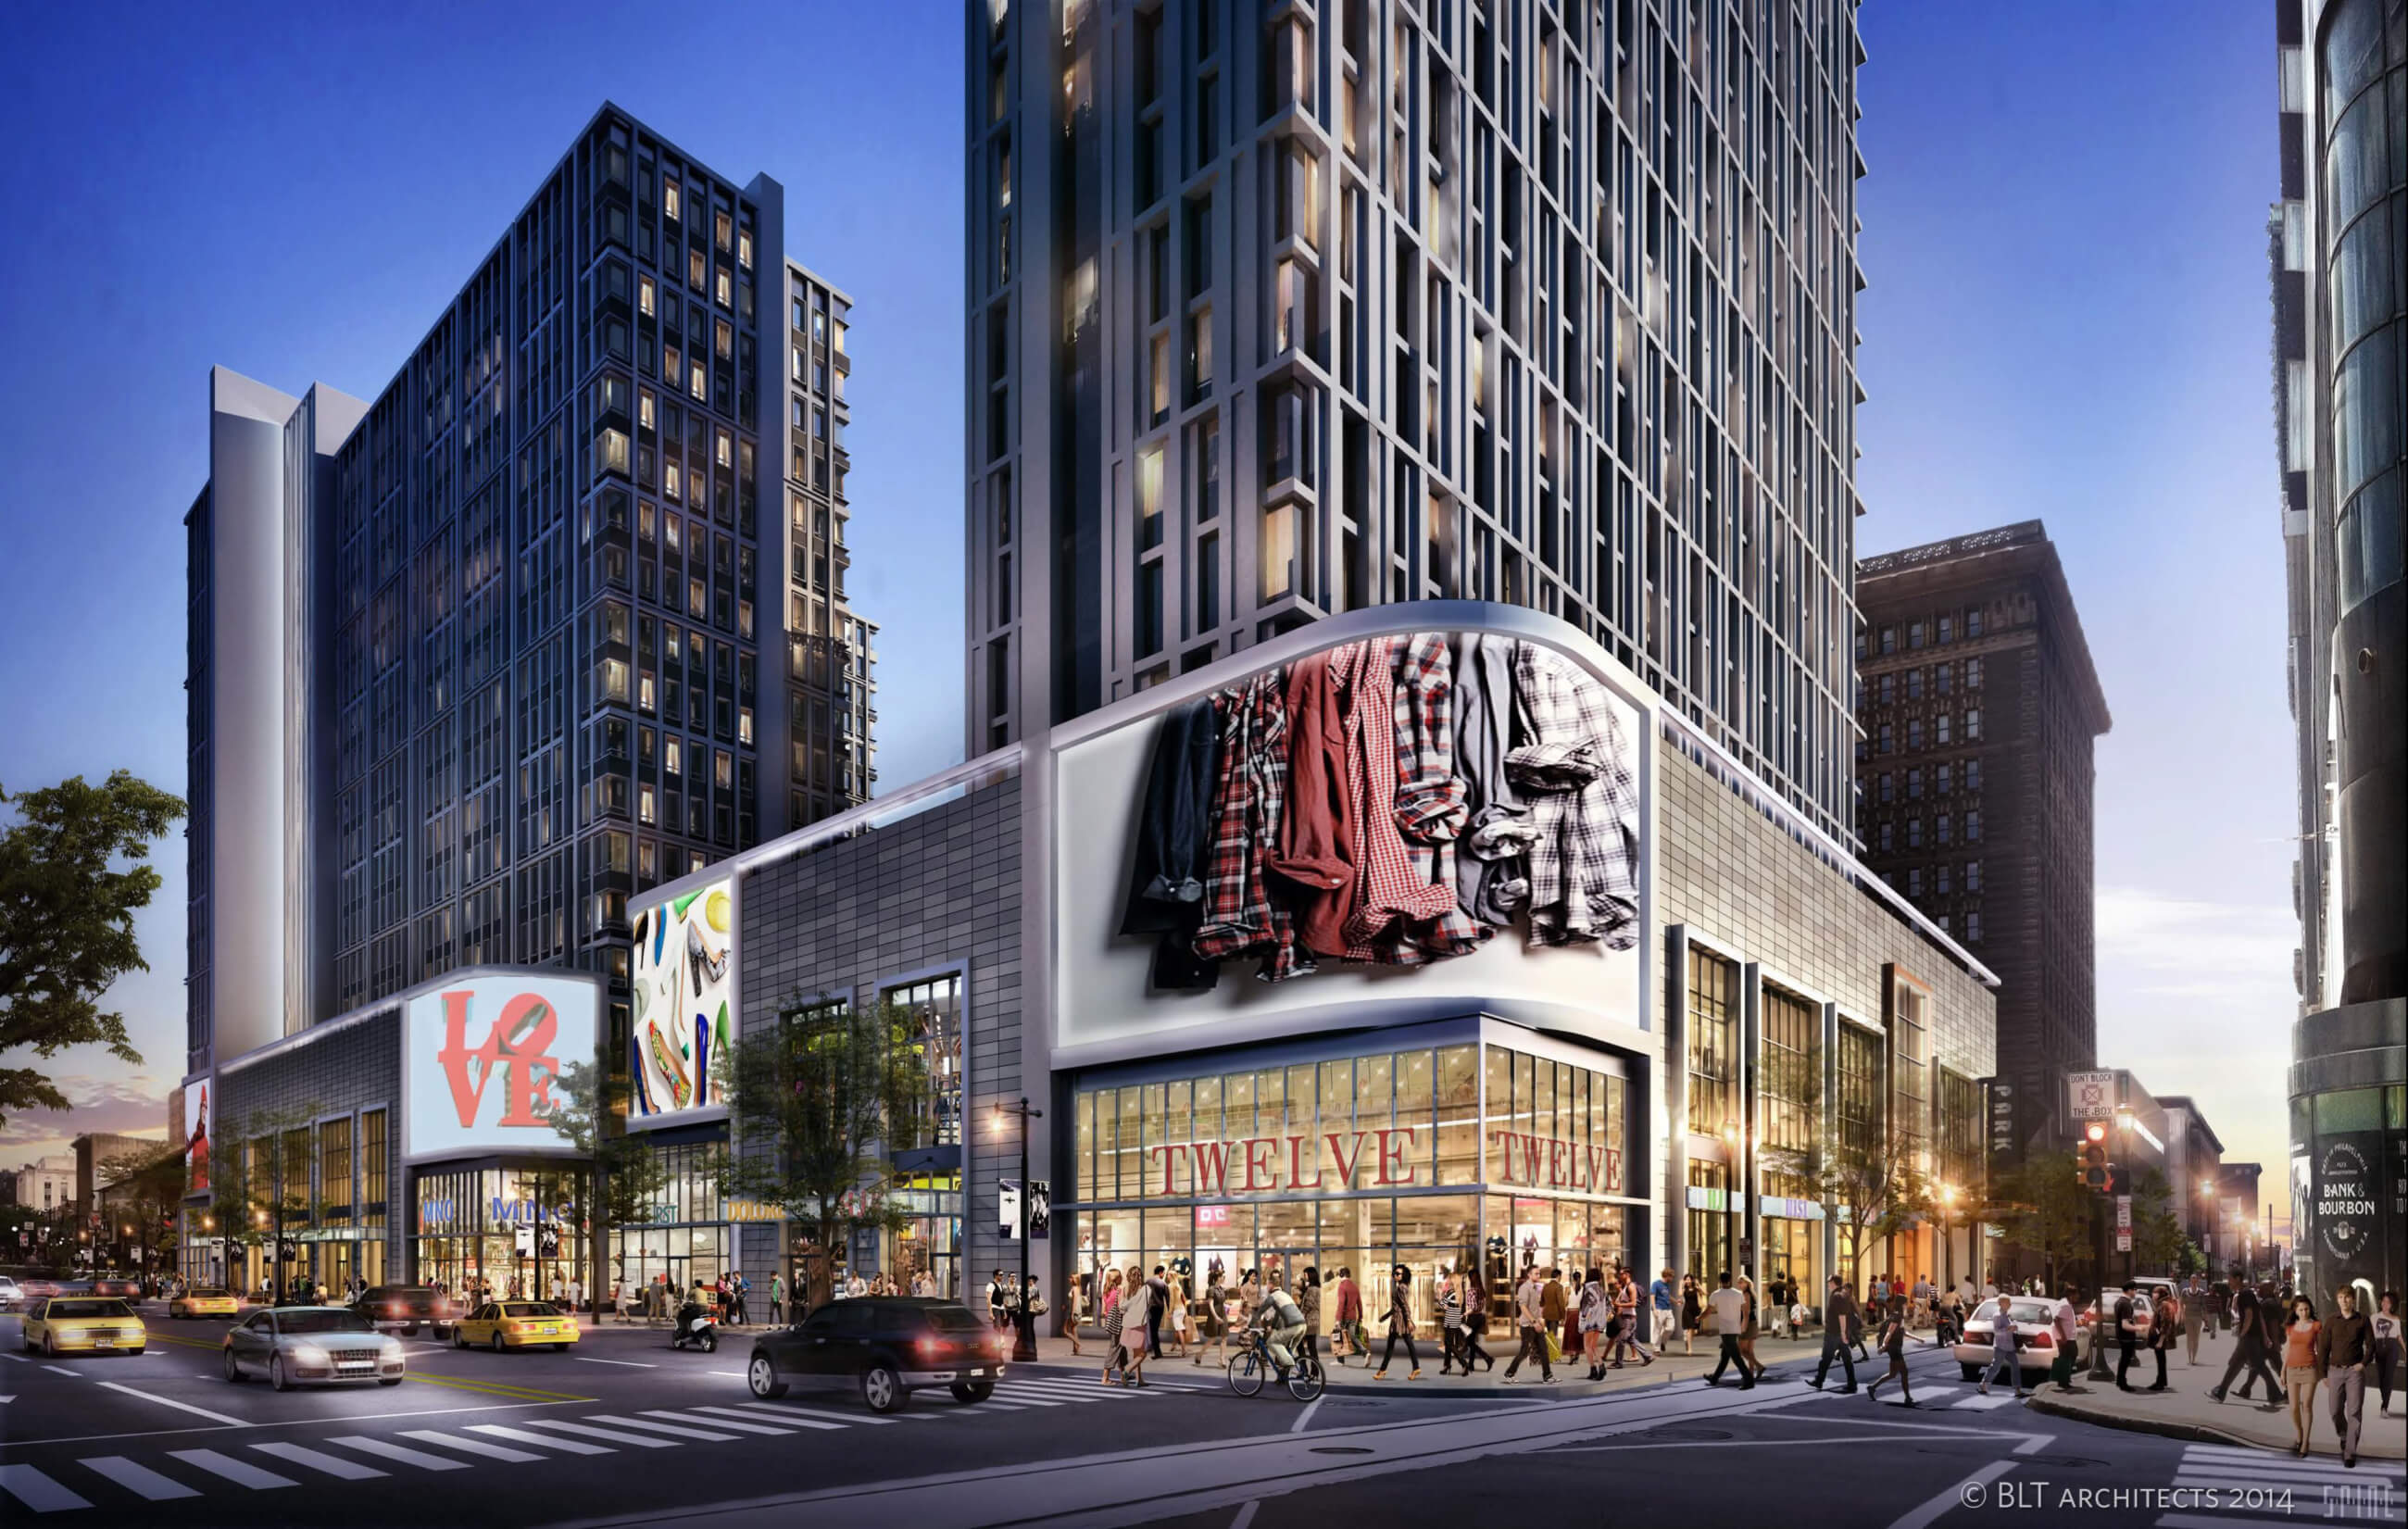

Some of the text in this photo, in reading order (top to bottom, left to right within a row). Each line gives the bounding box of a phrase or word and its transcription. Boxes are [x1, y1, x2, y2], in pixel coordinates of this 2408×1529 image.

[2090, 1073, 2113, 1083] BLOCK
[1994, 1085, 2013, 1151] PARK
[2074, 1106, 2113, 1117] THE BOX
[1151, 1127, 1415, 1196] TWELVE
[1496, 1130, 1622, 1191] TWELVE
[2324, 1183, 2364, 1197] BANK &
[423, 1198, 454, 1222] MNO
[2318, 1201, 2375, 1215] BOURBON
